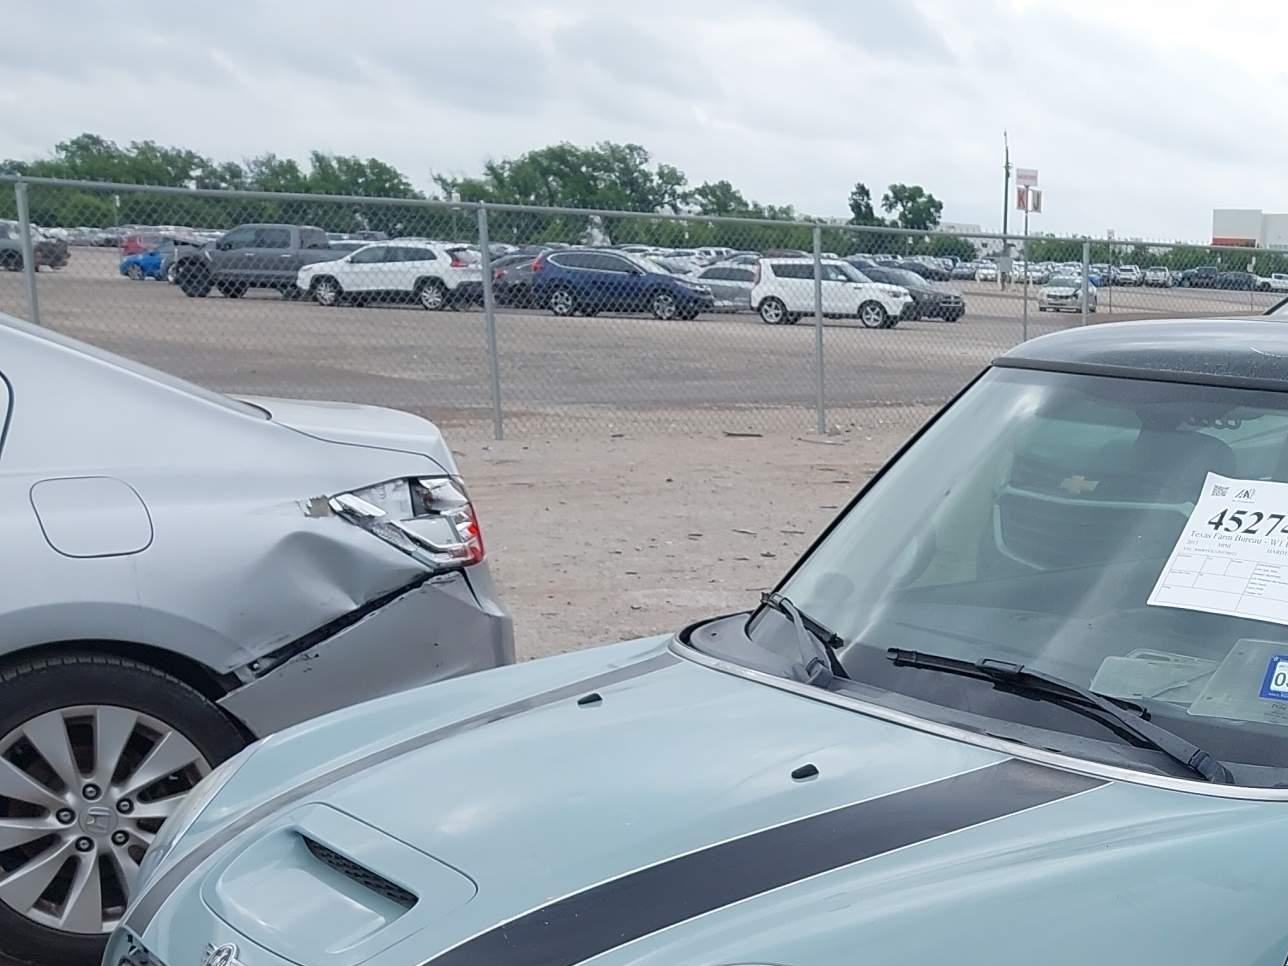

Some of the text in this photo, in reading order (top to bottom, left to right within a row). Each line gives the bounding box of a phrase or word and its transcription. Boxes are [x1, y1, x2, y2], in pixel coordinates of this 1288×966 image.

[1190, 530, 1211, 539] Texas
[1213, 532, 1233, 541] Farm
[1234, 534, 1262, 545] Bureau
